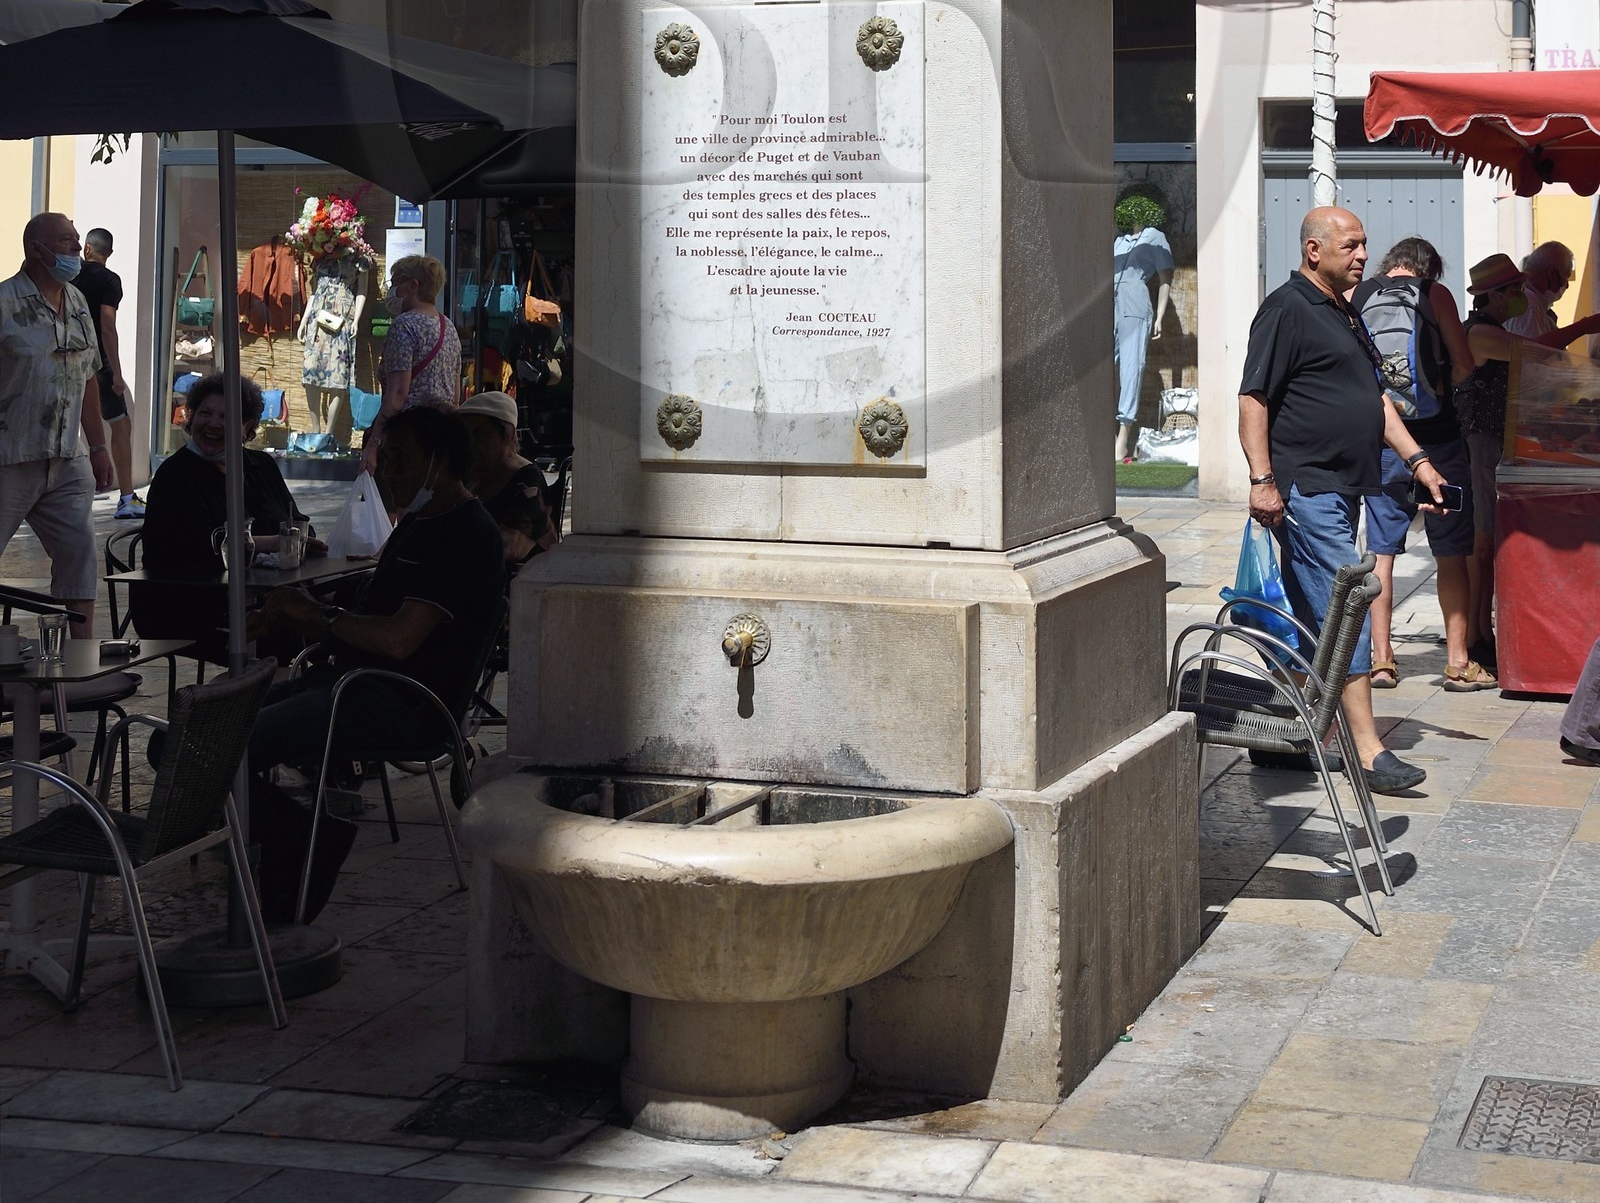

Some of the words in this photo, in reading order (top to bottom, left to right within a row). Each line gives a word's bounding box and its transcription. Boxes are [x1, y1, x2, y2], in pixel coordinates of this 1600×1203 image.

[1544, 48, 1600, 69] TRA
[754, 114, 778, 125] moi
[780, 113, 826, 125] Toulon
[828, 113, 848, 124] est
[674, 136, 699, 145] une
[701, 133, 729, 145] ville
[731, 132, 748, 144] de
[750, 132, 806, 147] province
[679, 155, 696, 164] un
[699, 152, 736, 164] décor
[738, 150, 754, 163] de
[755, 151, 795, 166] Puget
[797, 151, 811, 163] et
[813, 150, 830, 162] de
[832, 149, 881, 162] Vauban
[696, 174, 726, 183] avec
[728, 170, 751, 182] des
[752, 170, 808, 182] marchés
[810, 169, 833, 184] qui
[835, 170, 864, 181] sont
[682, 188, 704, 201] des
[706, 187, 756, 203] temples
[758, 191, 793, 203] grecs
[795, 189, 809, 201] et
[811, 188, 833, 200] des
[835, 188, 877, 203] places
[687, 208, 709, 222] qui
[711, 209, 739, 220] sont
[741, 208, 764, 220] des
[765, 207, 803, 220] salles
[805, 207, 828, 220] des
[665, 226, 691, 239] Elle
[693, 230, 712, 239] me
[715, 227, 784, 241] représente
[786, 226, 799, 239] la
[801, 227, 833, 241] paix,
[835, 226, 848, 238] le
[850, 229, 891, 241] repos,
[675, 245, 688, 257] la
[690, 245, 748, 259] noblesse,
[750, 245, 819, 260] l'élégance,
[820, 245, 832, 258] le
[706, 263, 767, 277] L'escadre
[769, 265, 811, 279] ajoute
[813, 265, 827, 277] la
[827, 264, 848, 277] vie
[730, 286, 743, 296] et
[745, 284, 759, 296] la
[785, 311, 813, 322] Jean
[818, 312, 877, 323] COCTEAU
[771, 325, 863, 339] Correspondance,
[866, 327, 891, 338] 1927
